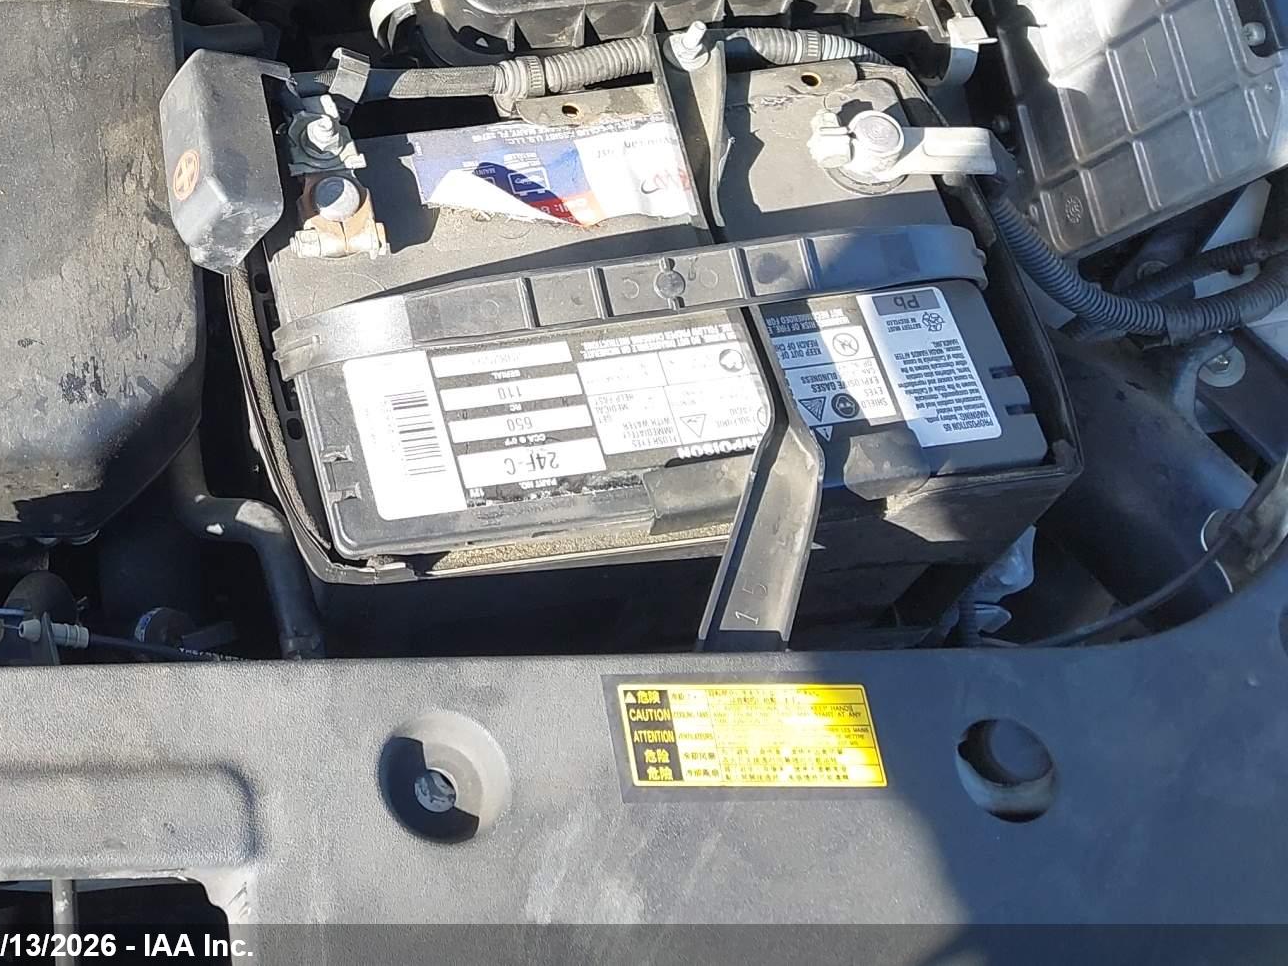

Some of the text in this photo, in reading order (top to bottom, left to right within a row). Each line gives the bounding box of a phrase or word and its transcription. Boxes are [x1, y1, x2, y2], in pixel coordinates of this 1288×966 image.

[892, 294, 920, 311] Pb
[787, 342, 795, 350] OF
[795, 339, 818, 349] REACH
[779, 347, 820, 359] KEEP OUT OF
[490, 368, 520, 380] SERIAL
[800, 371, 837, 384] BLINDNESS
[496, 384, 522, 400] 110
[810, 381, 836, 393] GASES
[863, 386, 883, 396] EYES
[508, 402, 522, 411] RC
[860, 396, 888, 409] SHIELD
[957, 409, 989, 420] WARNING:
[505, 415, 533, 432] 650
[951, 418, 993, 430] PROPOSITION
[527, 432, 546, 442] CCA
[503, 451, 559, 475] 24F-C
[518, 477, 557, 490] PART NO.
[629, 708, 672, 722] CAUTION
[633, 730, 675, 743] ATTENTION
